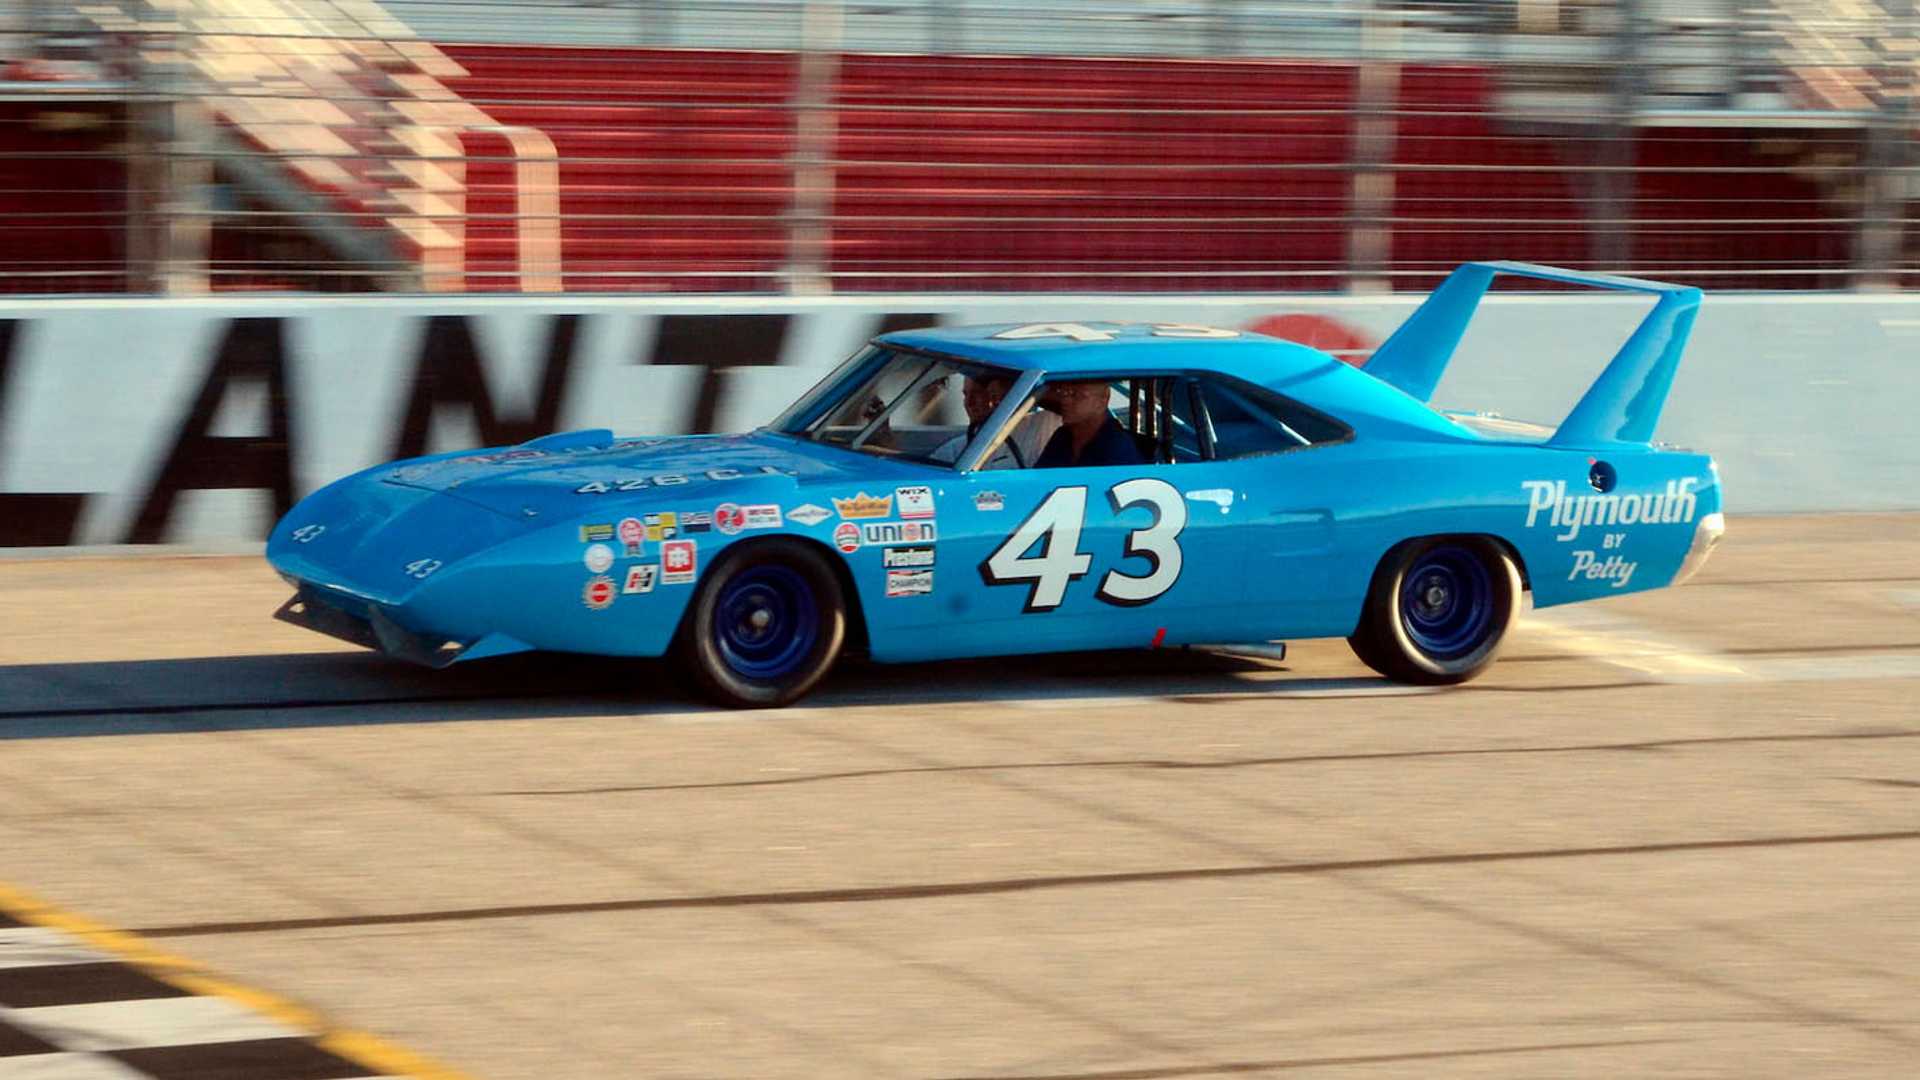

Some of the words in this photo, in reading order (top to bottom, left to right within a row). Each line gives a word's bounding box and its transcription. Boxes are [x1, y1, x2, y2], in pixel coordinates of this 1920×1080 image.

[576, 473, 689, 494] 426
[1521, 477, 1698, 542] Plymouth
[292, 524, 327, 544] 43
[1603, 533, 1627, 549] BY
[978, 477, 1189, 614] 43
[405, 557, 444, 579] 43
[1567, 550, 1638, 588] Petty
